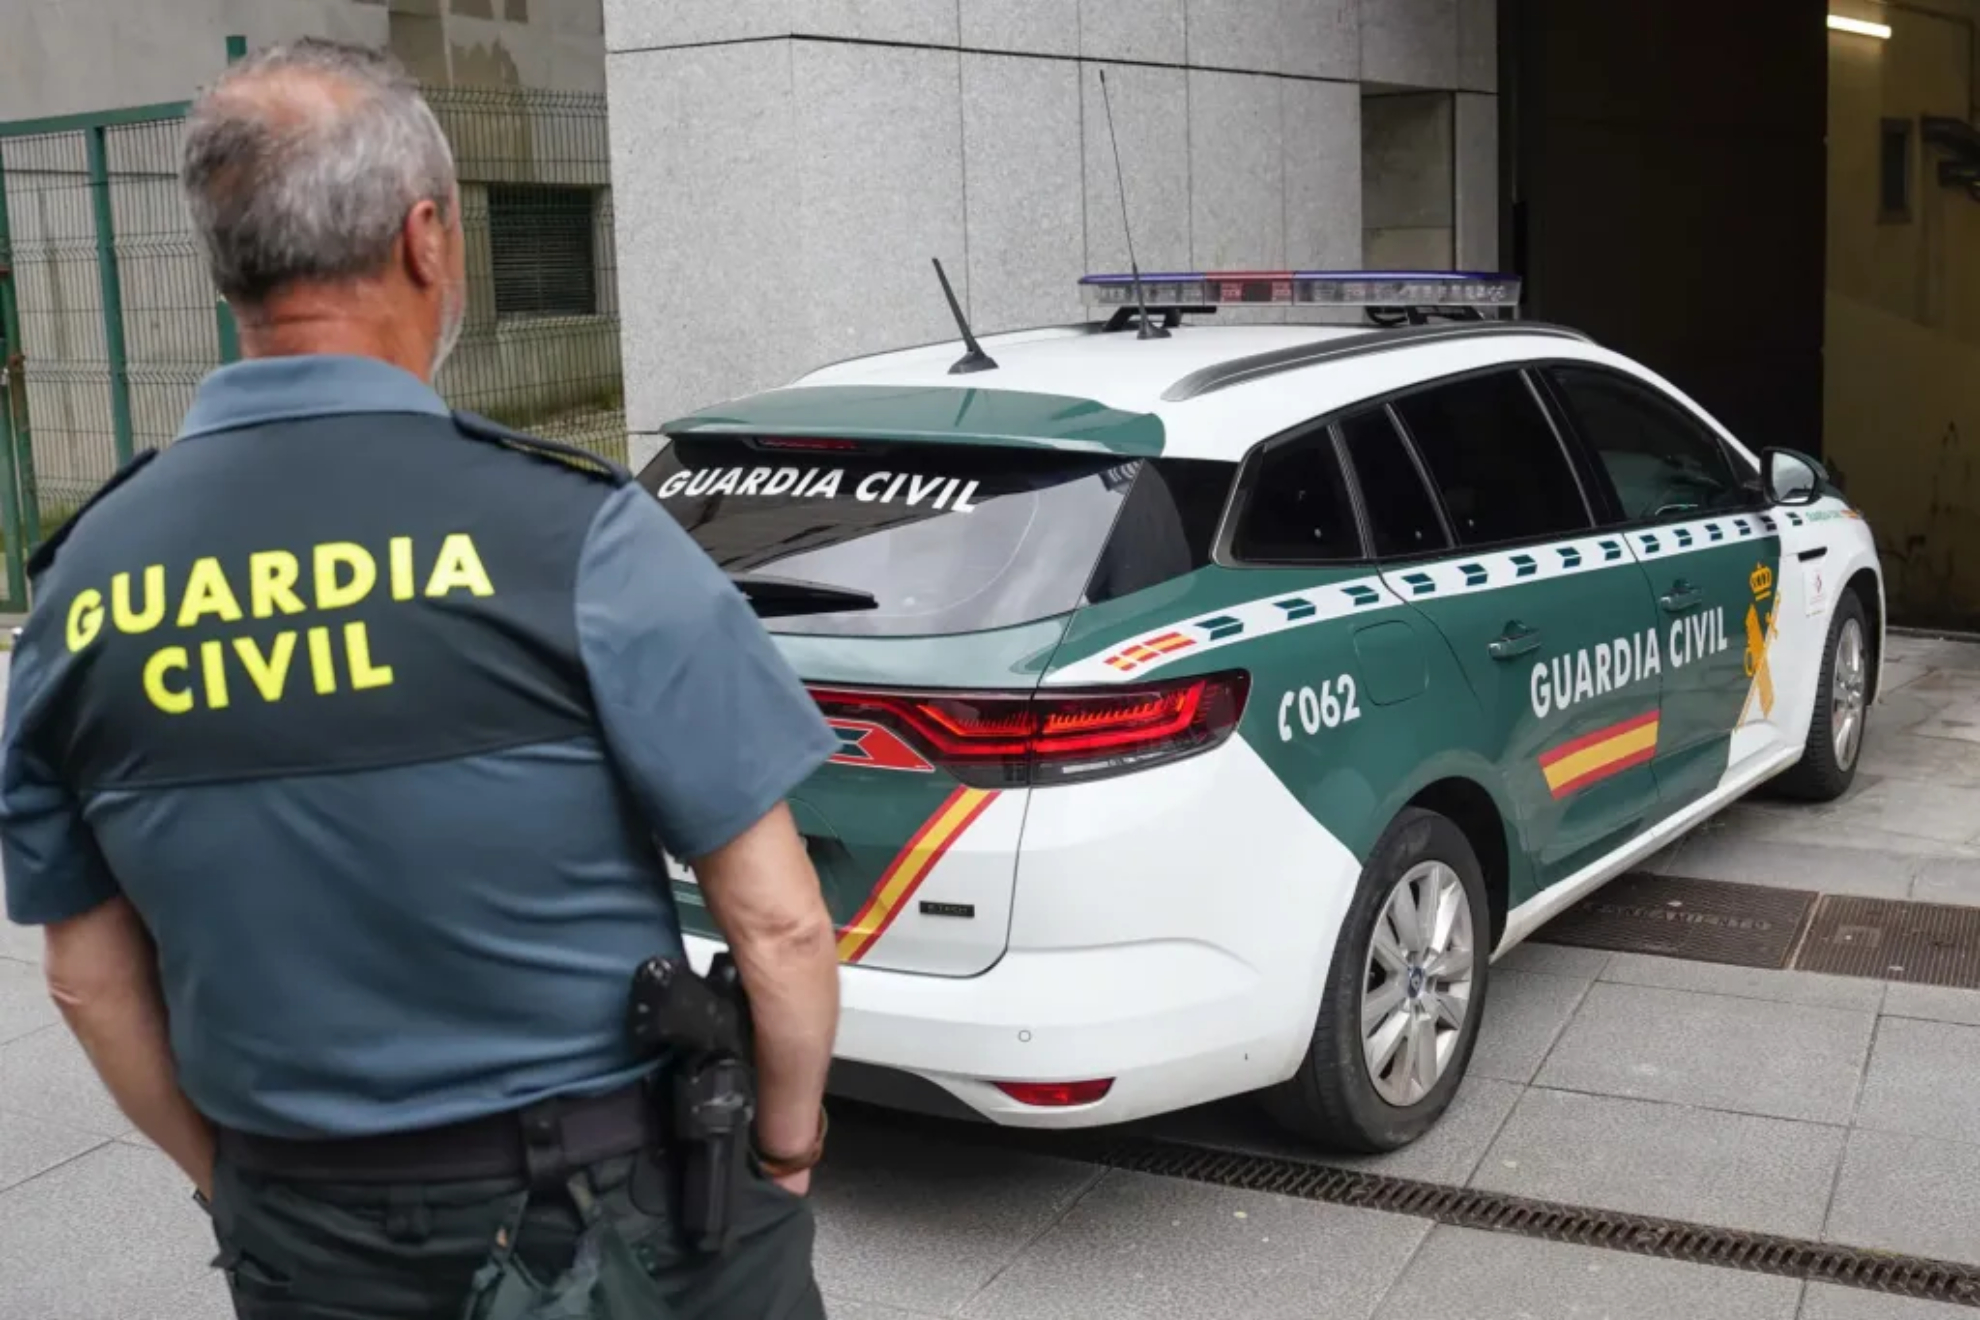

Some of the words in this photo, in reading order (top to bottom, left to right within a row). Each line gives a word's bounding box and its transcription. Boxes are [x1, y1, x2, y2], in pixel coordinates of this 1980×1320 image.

[657, 467, 843, 499] GUARDIA
[855, 472, 979, 513] CIVIL
[65, 533, 494, 653] GUARDIA
[143, 621, 394, 714] CIVIL
[1299, 673, 1362, 736] 062
[1530, 626, 1662, 719] GUARDIA
[1669, 605, 1728, 668] CIVIL
